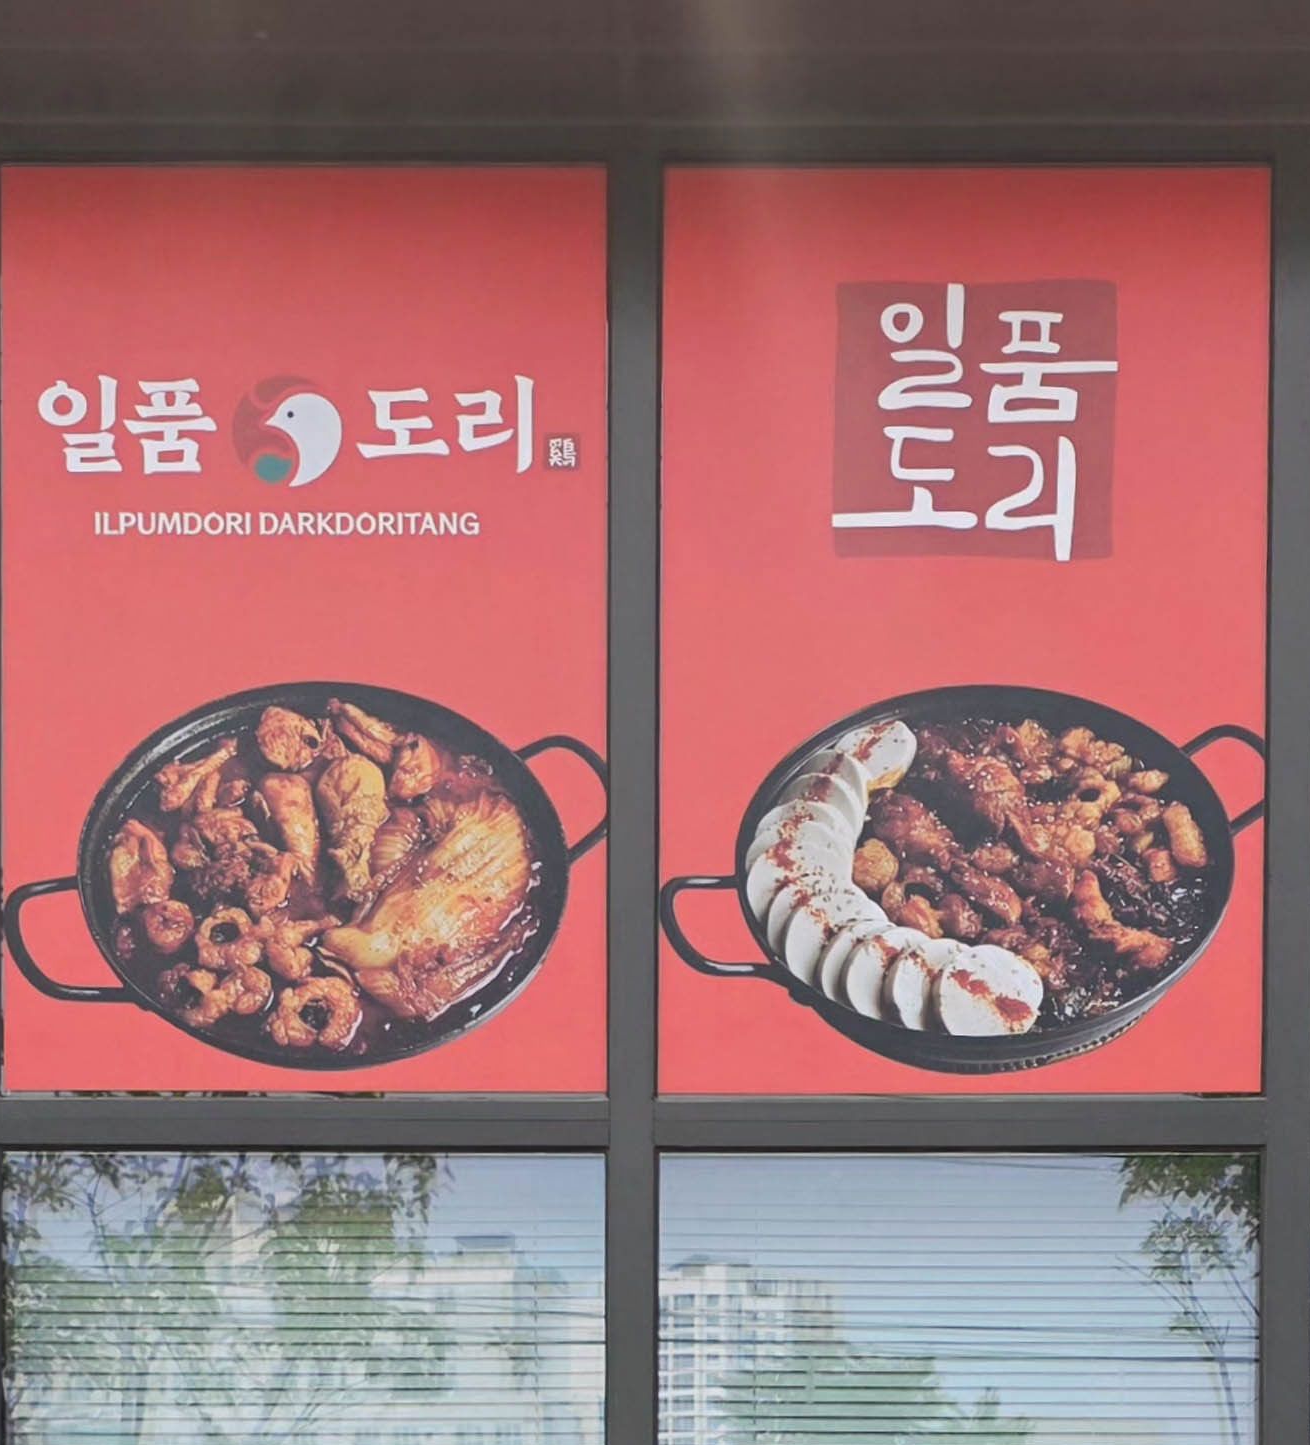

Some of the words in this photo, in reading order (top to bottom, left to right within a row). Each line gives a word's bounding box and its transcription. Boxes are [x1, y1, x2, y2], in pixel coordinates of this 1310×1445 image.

[877, 283, 1118, 424] 일품
[38, 374, 218, 475] 일품
[356, 375, 534, 474] 도리
[94, 511, 252, 536] ILPUMDORI
[259, 511, 480, 536] DARKDORITANG
[831, 427, 1076, 561] 도리
